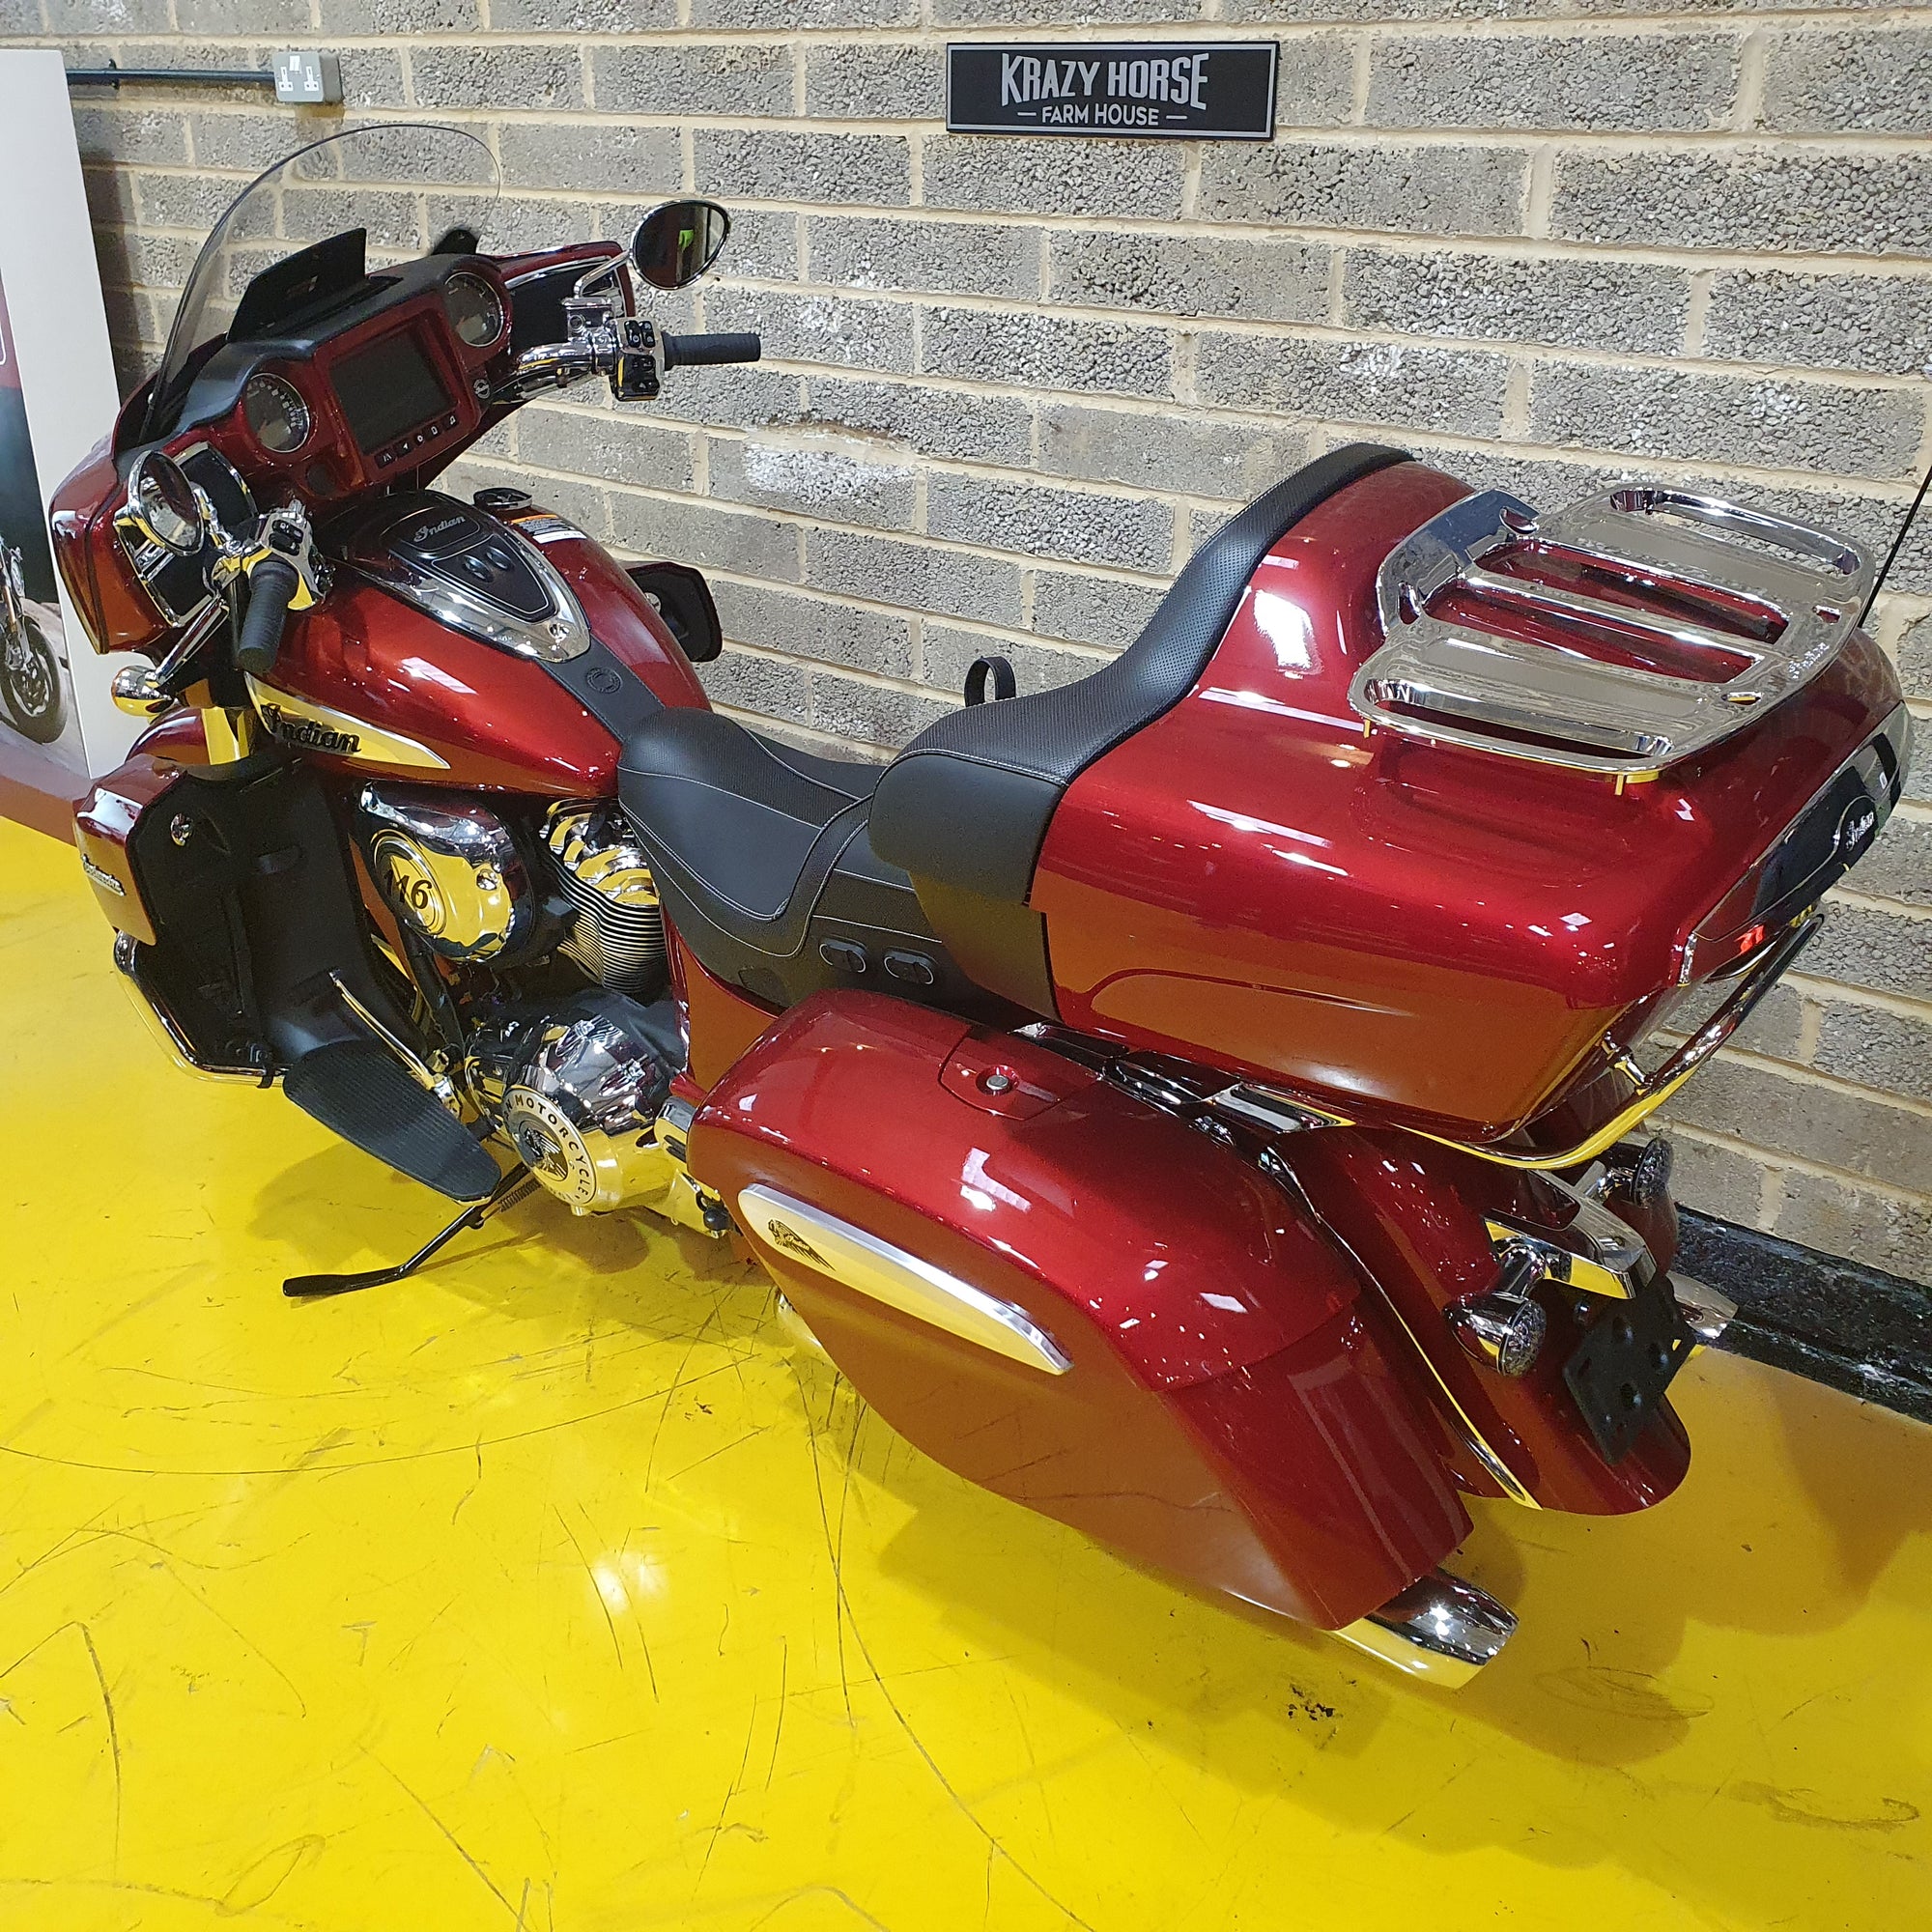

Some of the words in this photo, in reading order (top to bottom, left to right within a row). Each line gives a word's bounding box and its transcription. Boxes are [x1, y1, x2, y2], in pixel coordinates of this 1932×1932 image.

[1001, 53, 1100, 107] KRAZY
[1108, 52, 1209, 110] HORSE
[1041, 103, 1089, 124] FARM
[1094, 103, 1159, 126] HOUSE
[413, 516, 466, 543] Indian
[260, 702, 362, 753] Indian
[515, 1094, 591, 1196] MOTORCYCLE
